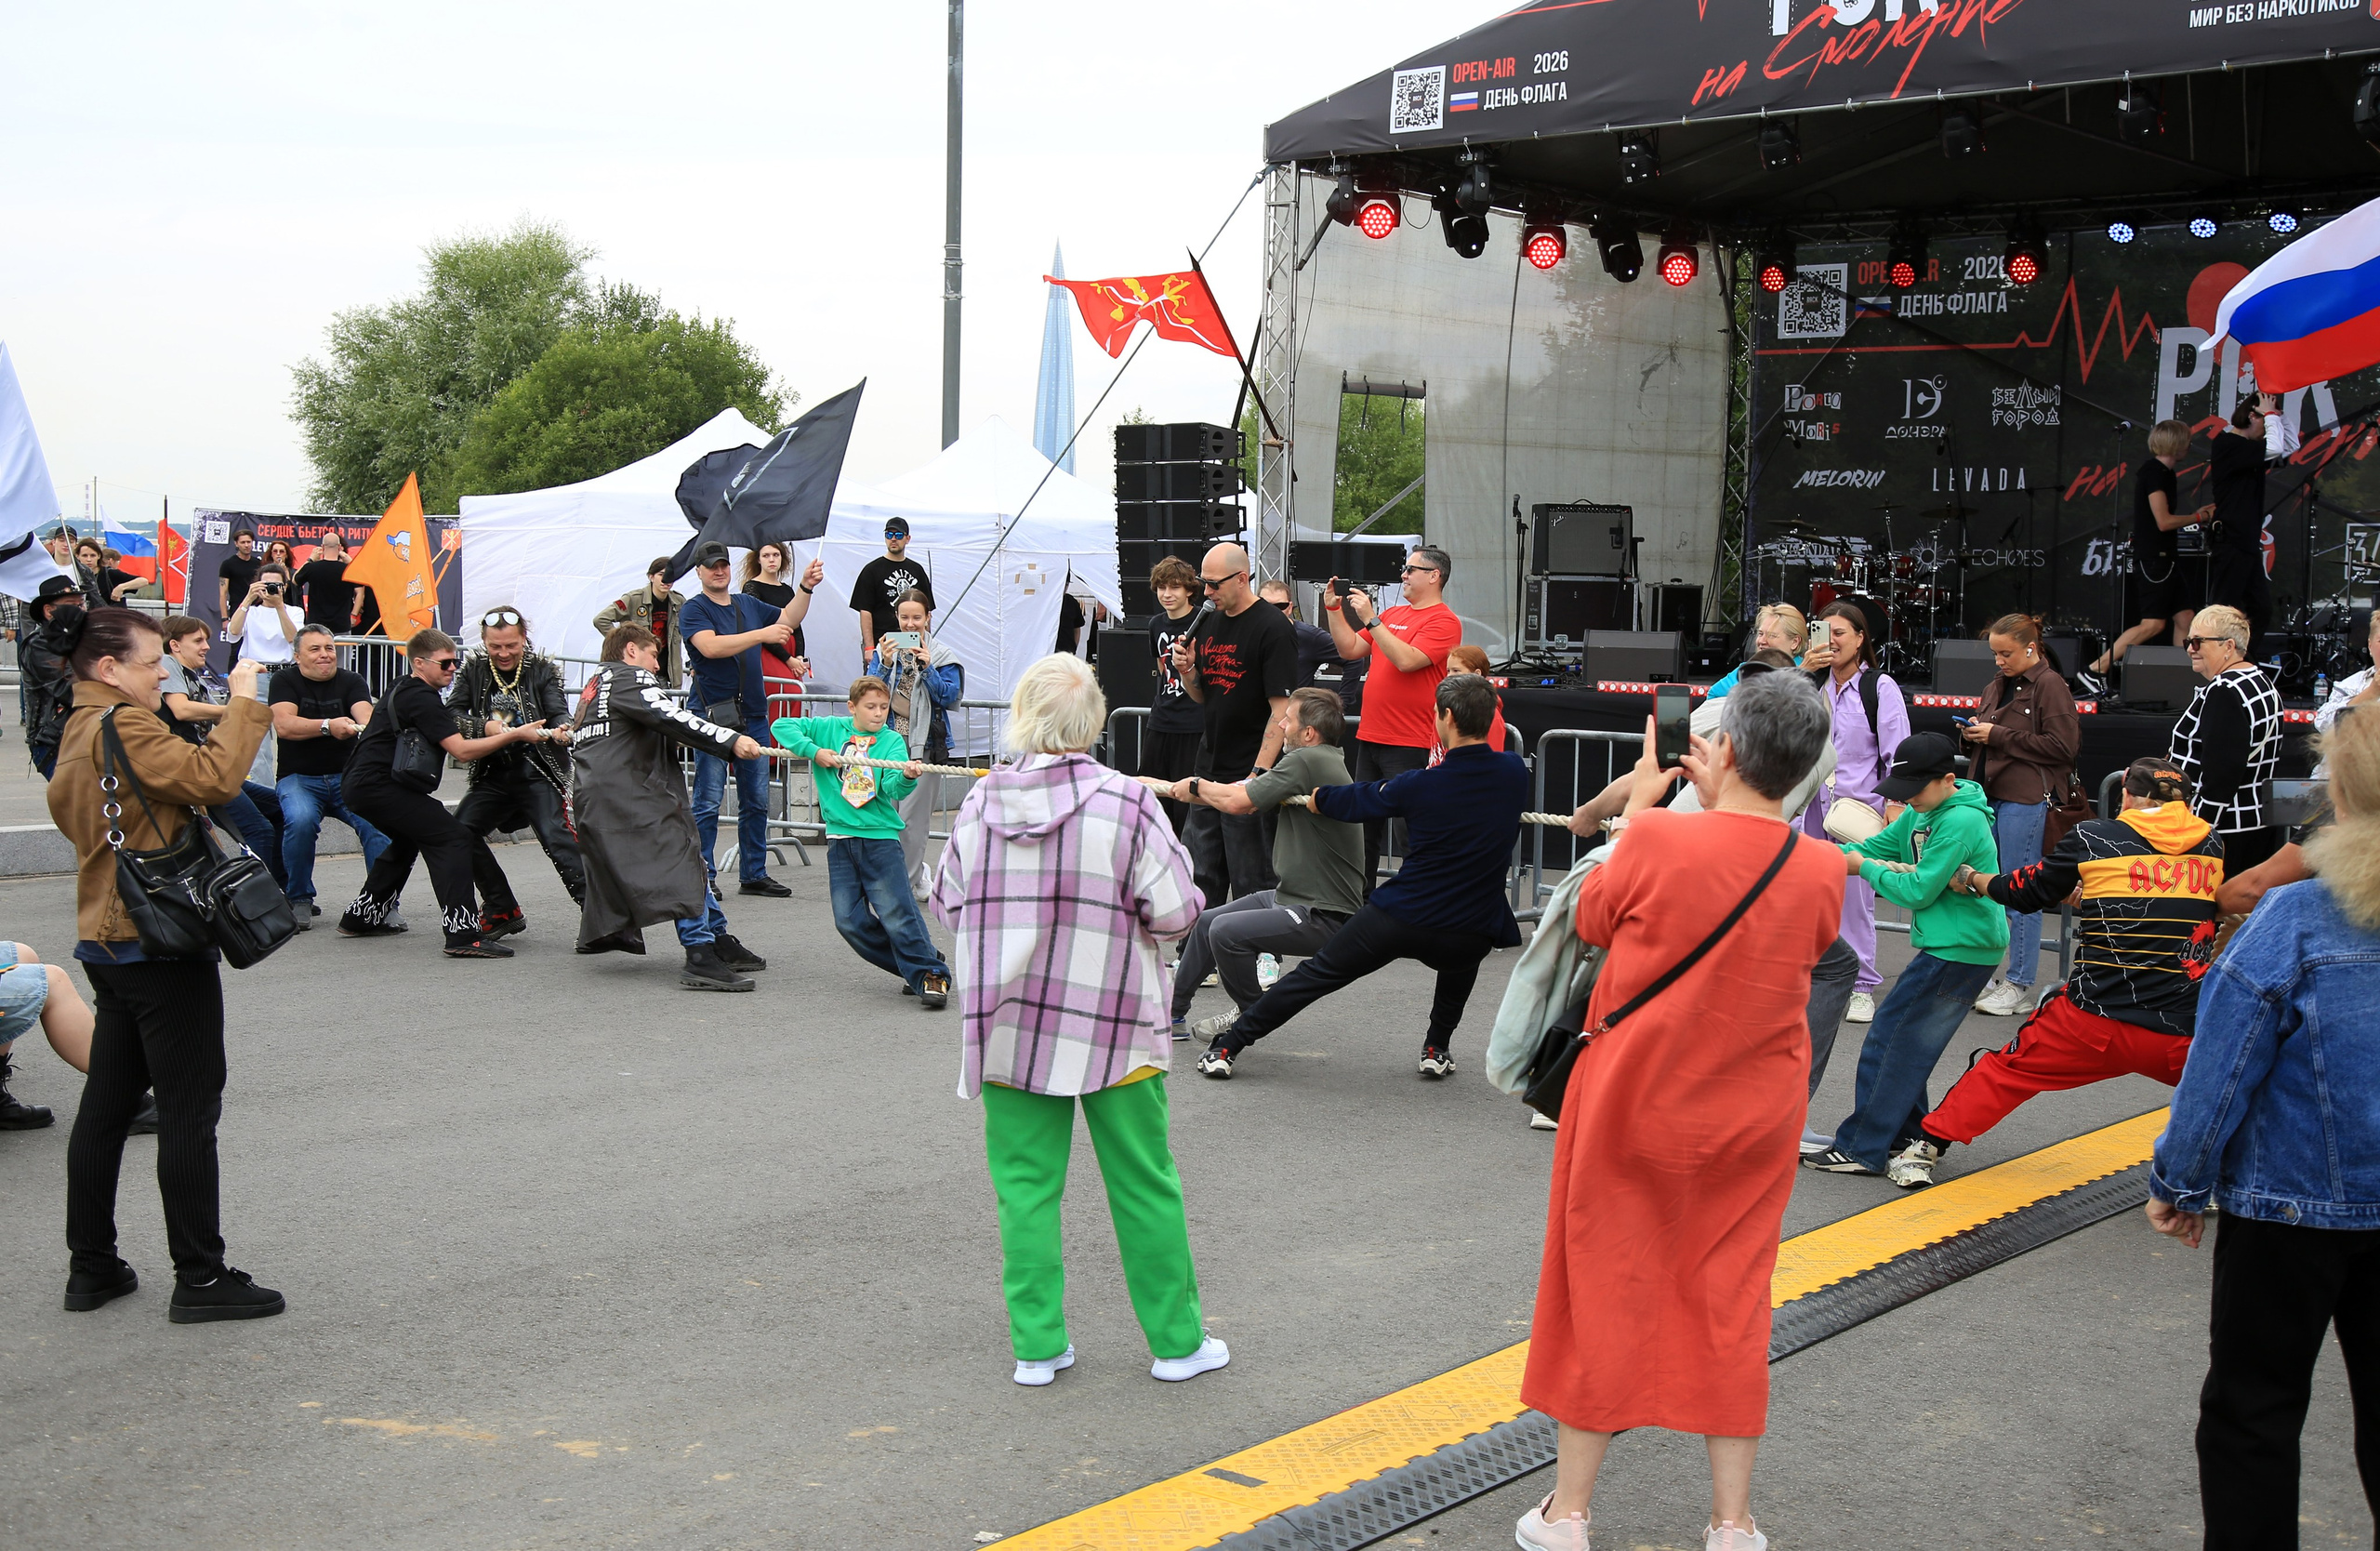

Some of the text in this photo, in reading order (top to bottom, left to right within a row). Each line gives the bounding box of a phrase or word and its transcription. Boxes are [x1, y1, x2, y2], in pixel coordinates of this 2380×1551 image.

[2189, 7, 2223, 29] МИР
[2226, 4, 2254, 24] БЕЗ
[1452, 49, 1570, 84] OPEN-AIR 2026
[1691, 60, 1749, 106] на
[1483, 81, 1568, 112] ДЕНЬ ФЛАГА
[1897, 291, 2008, 318] ДЕНЬ ФЛАГА
[1991, 377, 2061, 409] БЕЛЫЙ
[1991, 406, 2061, 432] ГОРОД
[1792, 469, 1886, 489] MELORIN
[1932, 467, 2026, 492] LEVADA
[257, 523, 296, 539] СЕРДЦЕ
[298, 525, 336, 539] БЬЕТСЯ
[337, 526, 345, 537] В
[888, 568, 915, 585] AMITY
[2128, 856, 2218, 896] AC/DC
